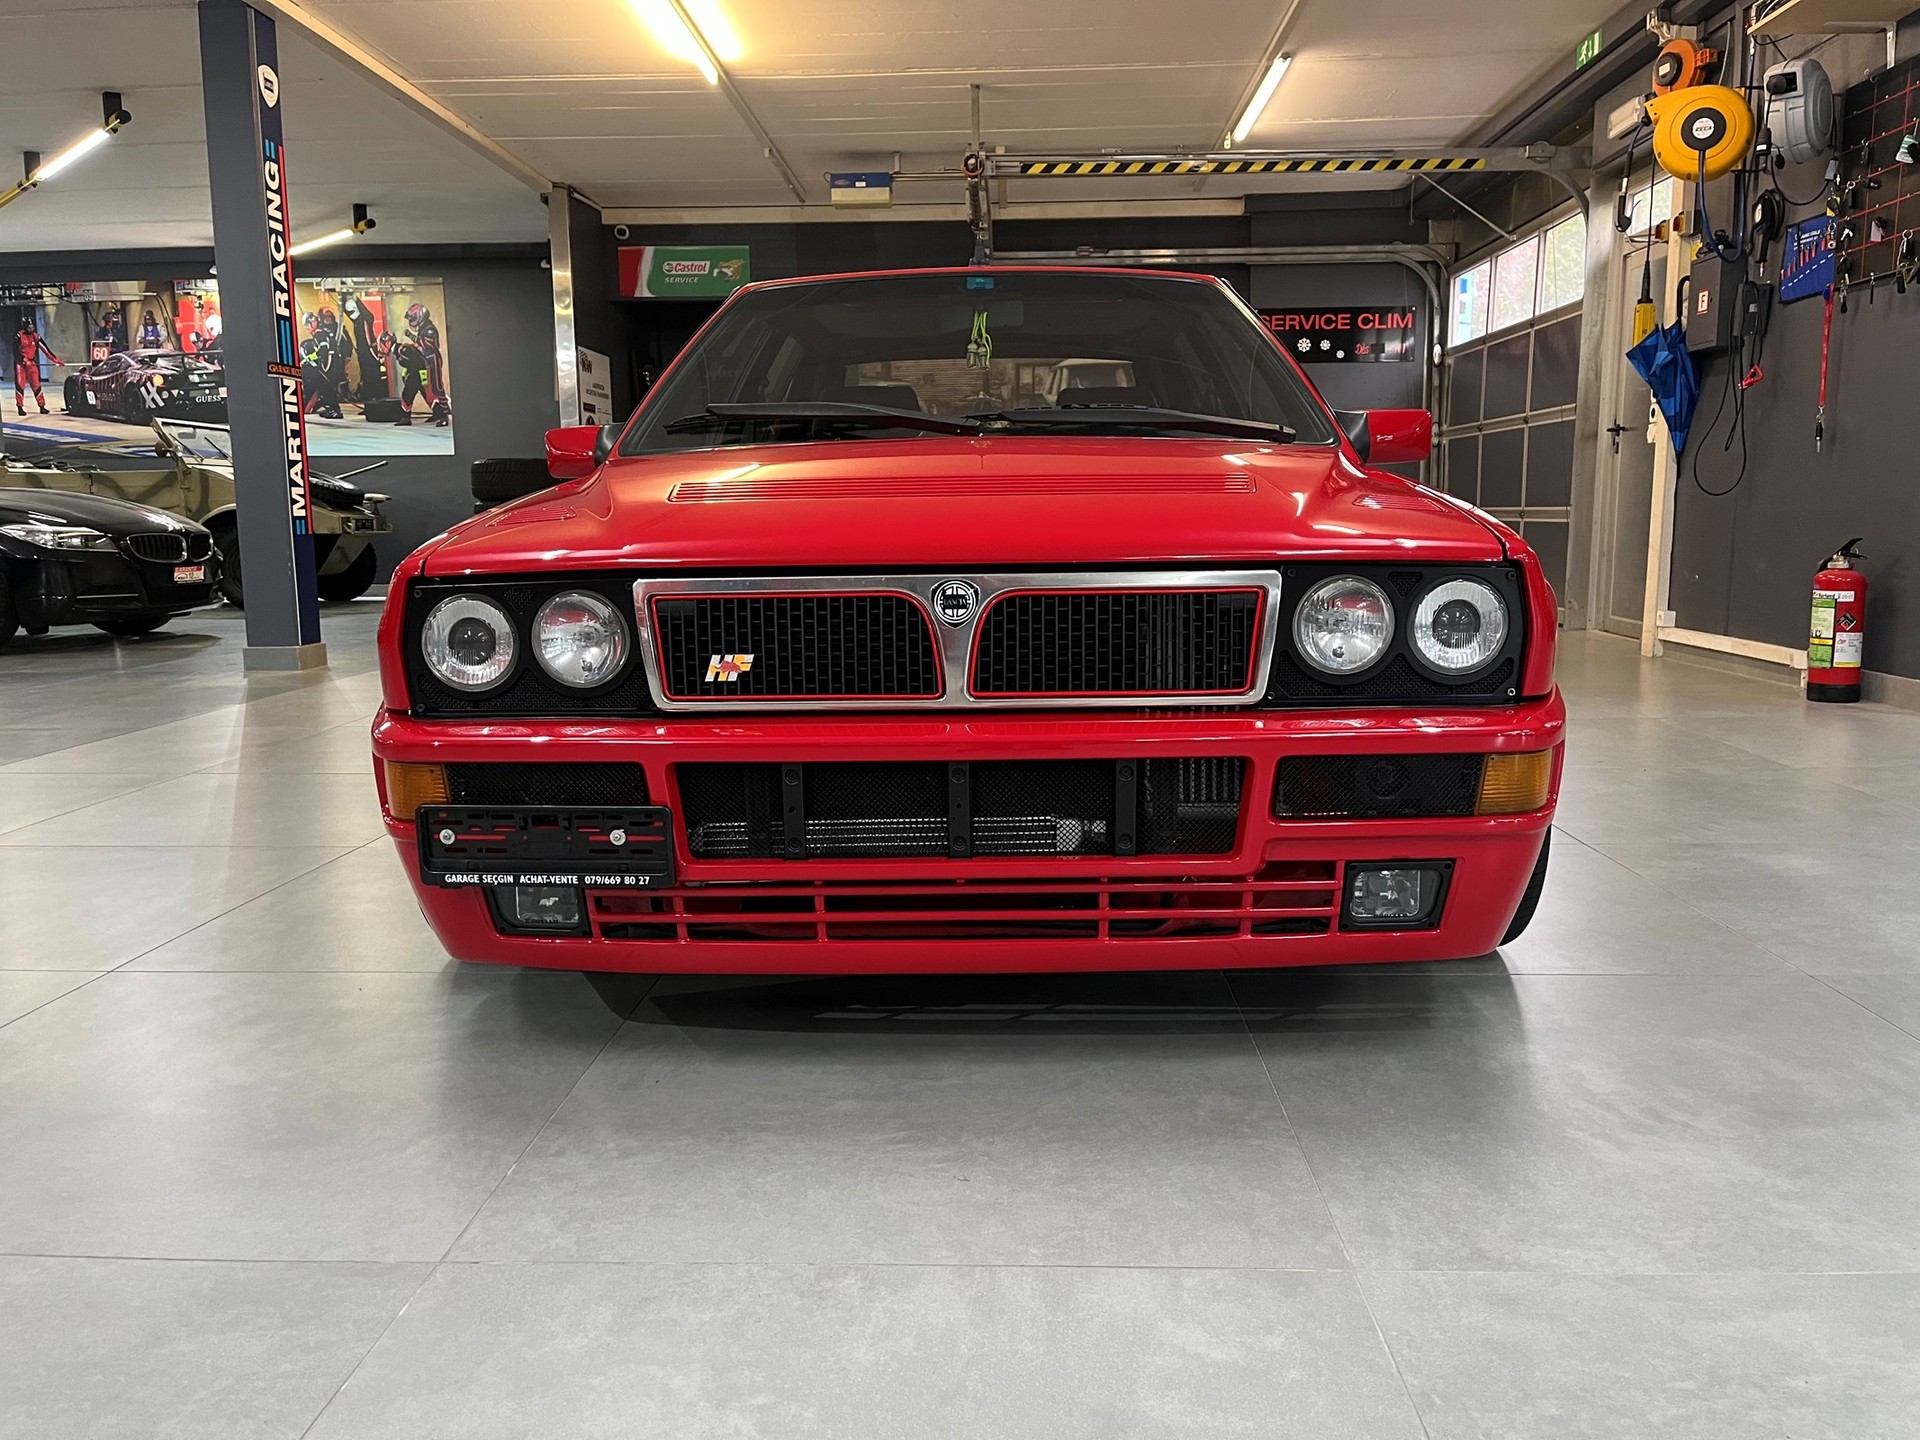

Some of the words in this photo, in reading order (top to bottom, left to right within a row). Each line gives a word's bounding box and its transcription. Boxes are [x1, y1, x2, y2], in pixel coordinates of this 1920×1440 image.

[265, 160, 290, 317] RACING
[674, 262, 707, 273] Castrol
[664, 276, 699, 284] SERVICE
[1357, 313, 1413, 330] CLIM
[93, 348, 108, 360] 60
[195, 395, 222, 403] GUESS
[282, 378, 306, 517] MARTIN
[704, 653, 755, 682] HF
[444, 874, 480, 884] GARAGE
[482, 874, 514, 886] SEÇGIN
[519, 875, 579, 885] ACHAT-VENTE
[584, 875, 622, 886] 079/669
[624, 876, 636, 885] 80
[638, 876, 650, 885] 27
